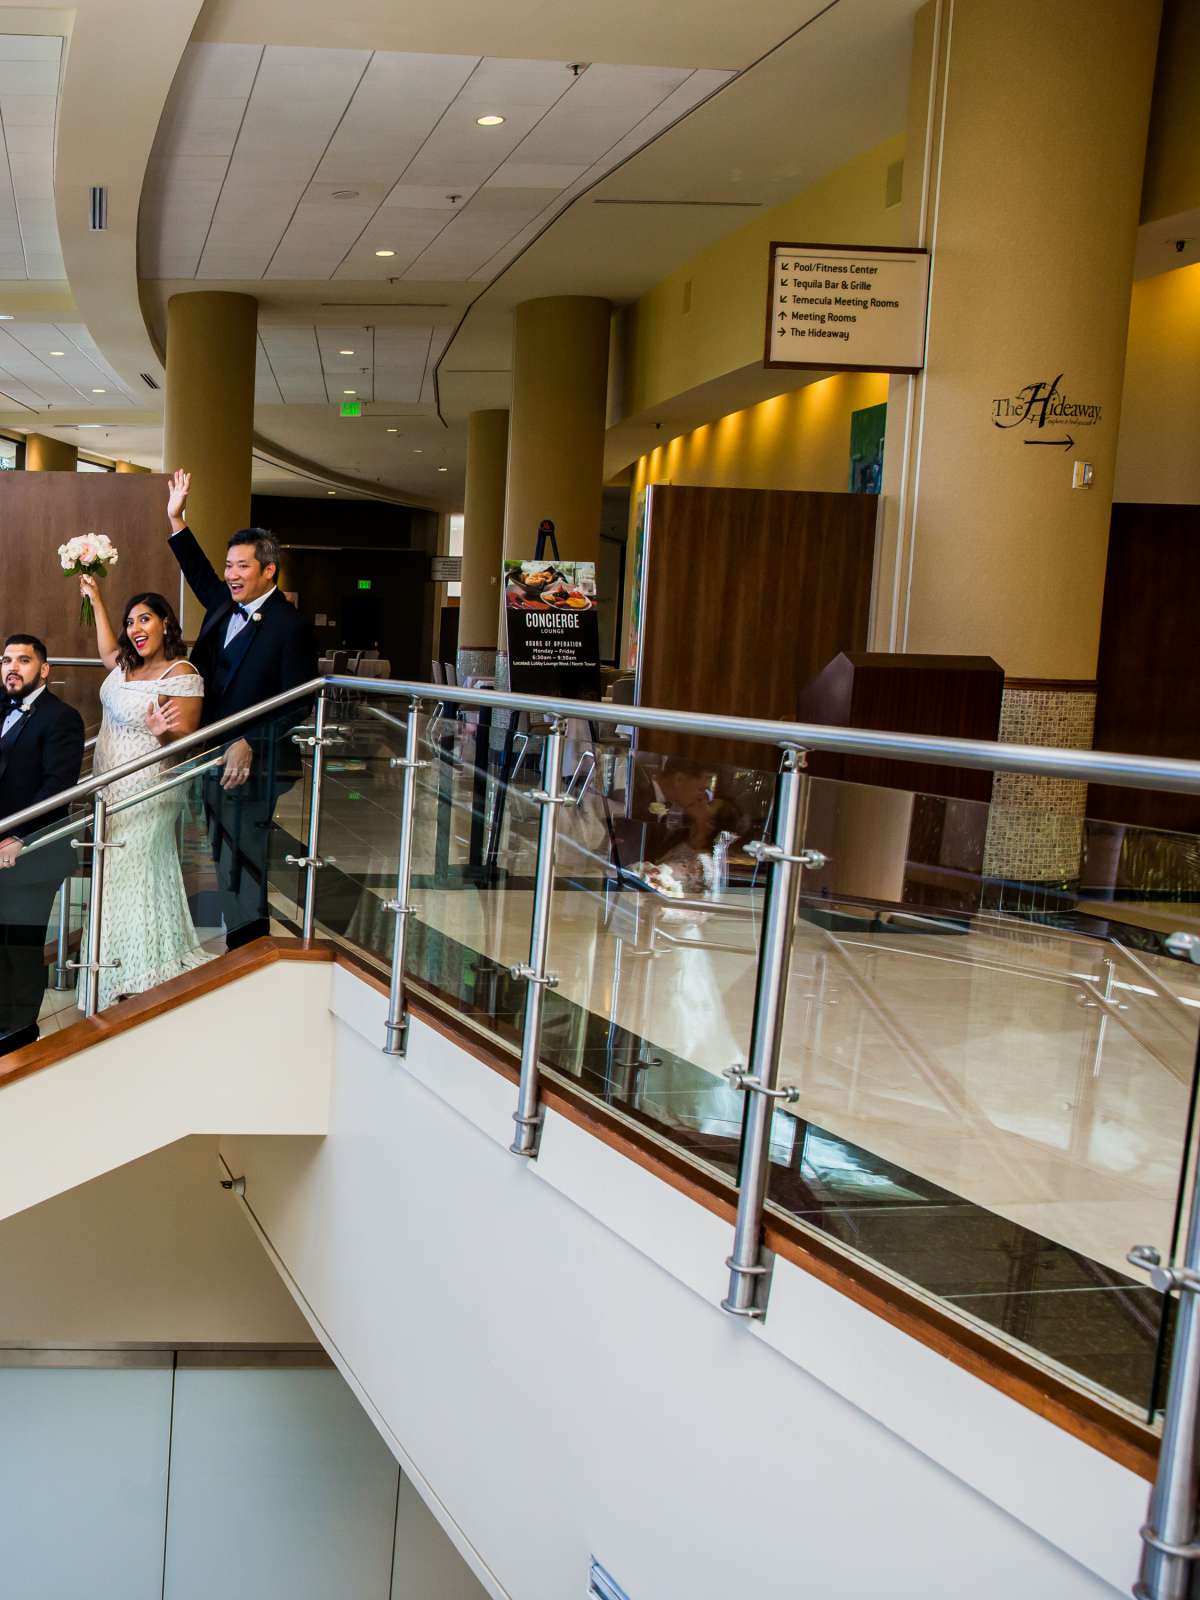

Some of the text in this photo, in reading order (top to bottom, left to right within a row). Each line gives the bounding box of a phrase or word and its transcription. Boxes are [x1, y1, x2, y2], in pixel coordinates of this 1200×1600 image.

[793, 262, 879, 275] Pool/Fitness Center
[793, 279, 872, 291] Tequila Bar & Grille
[792, 295, 899, 309] Temecula Meeting Rooms
[791, 312, 857, 324] Meeting Rooms
[790, 327, 849, 341] The Hideaway
[992, 373, 1102, 429] The Hideaway
[525, 612, 580, 629] CONCIERGE
